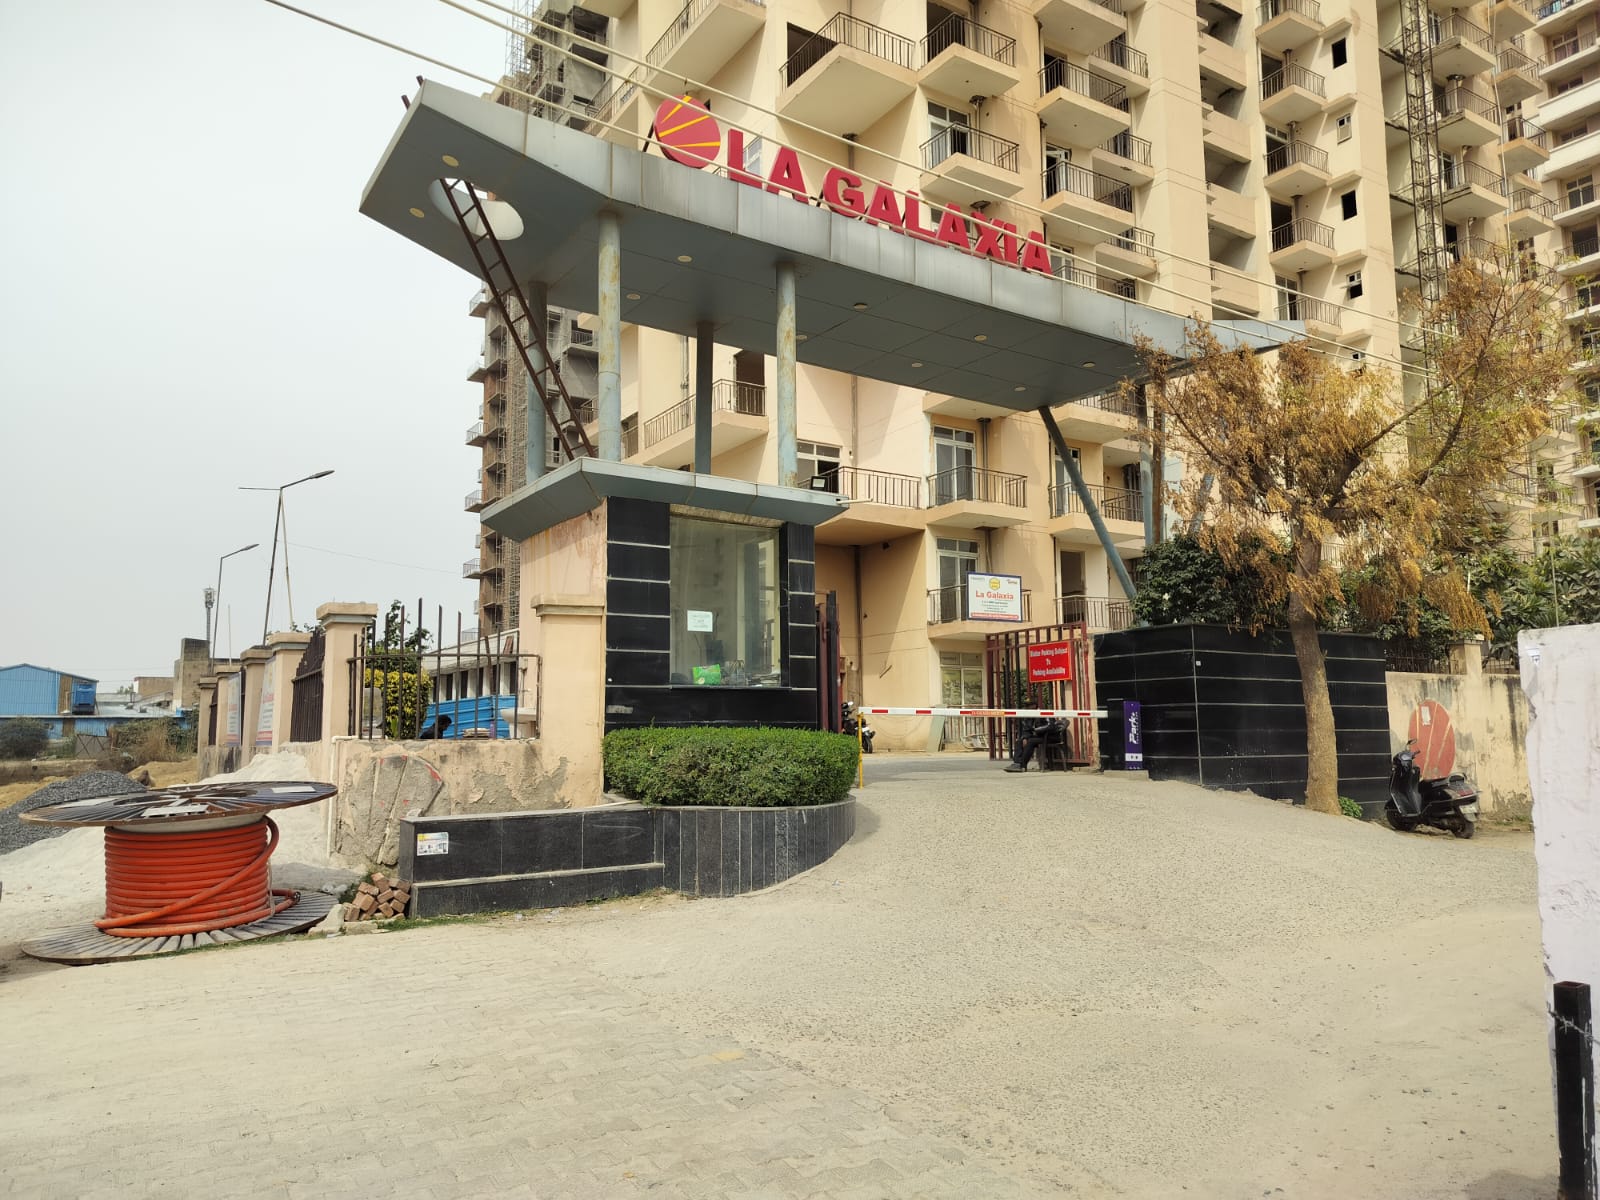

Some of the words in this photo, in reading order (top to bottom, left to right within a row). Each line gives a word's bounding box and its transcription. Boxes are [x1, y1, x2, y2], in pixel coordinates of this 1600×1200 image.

[727, 128, 810, 203] LA
[822, 167, 1053, 275] GALAXIA
[975, 590, 985, 598] La
[986, 591, 1014, 600] Galaxia
